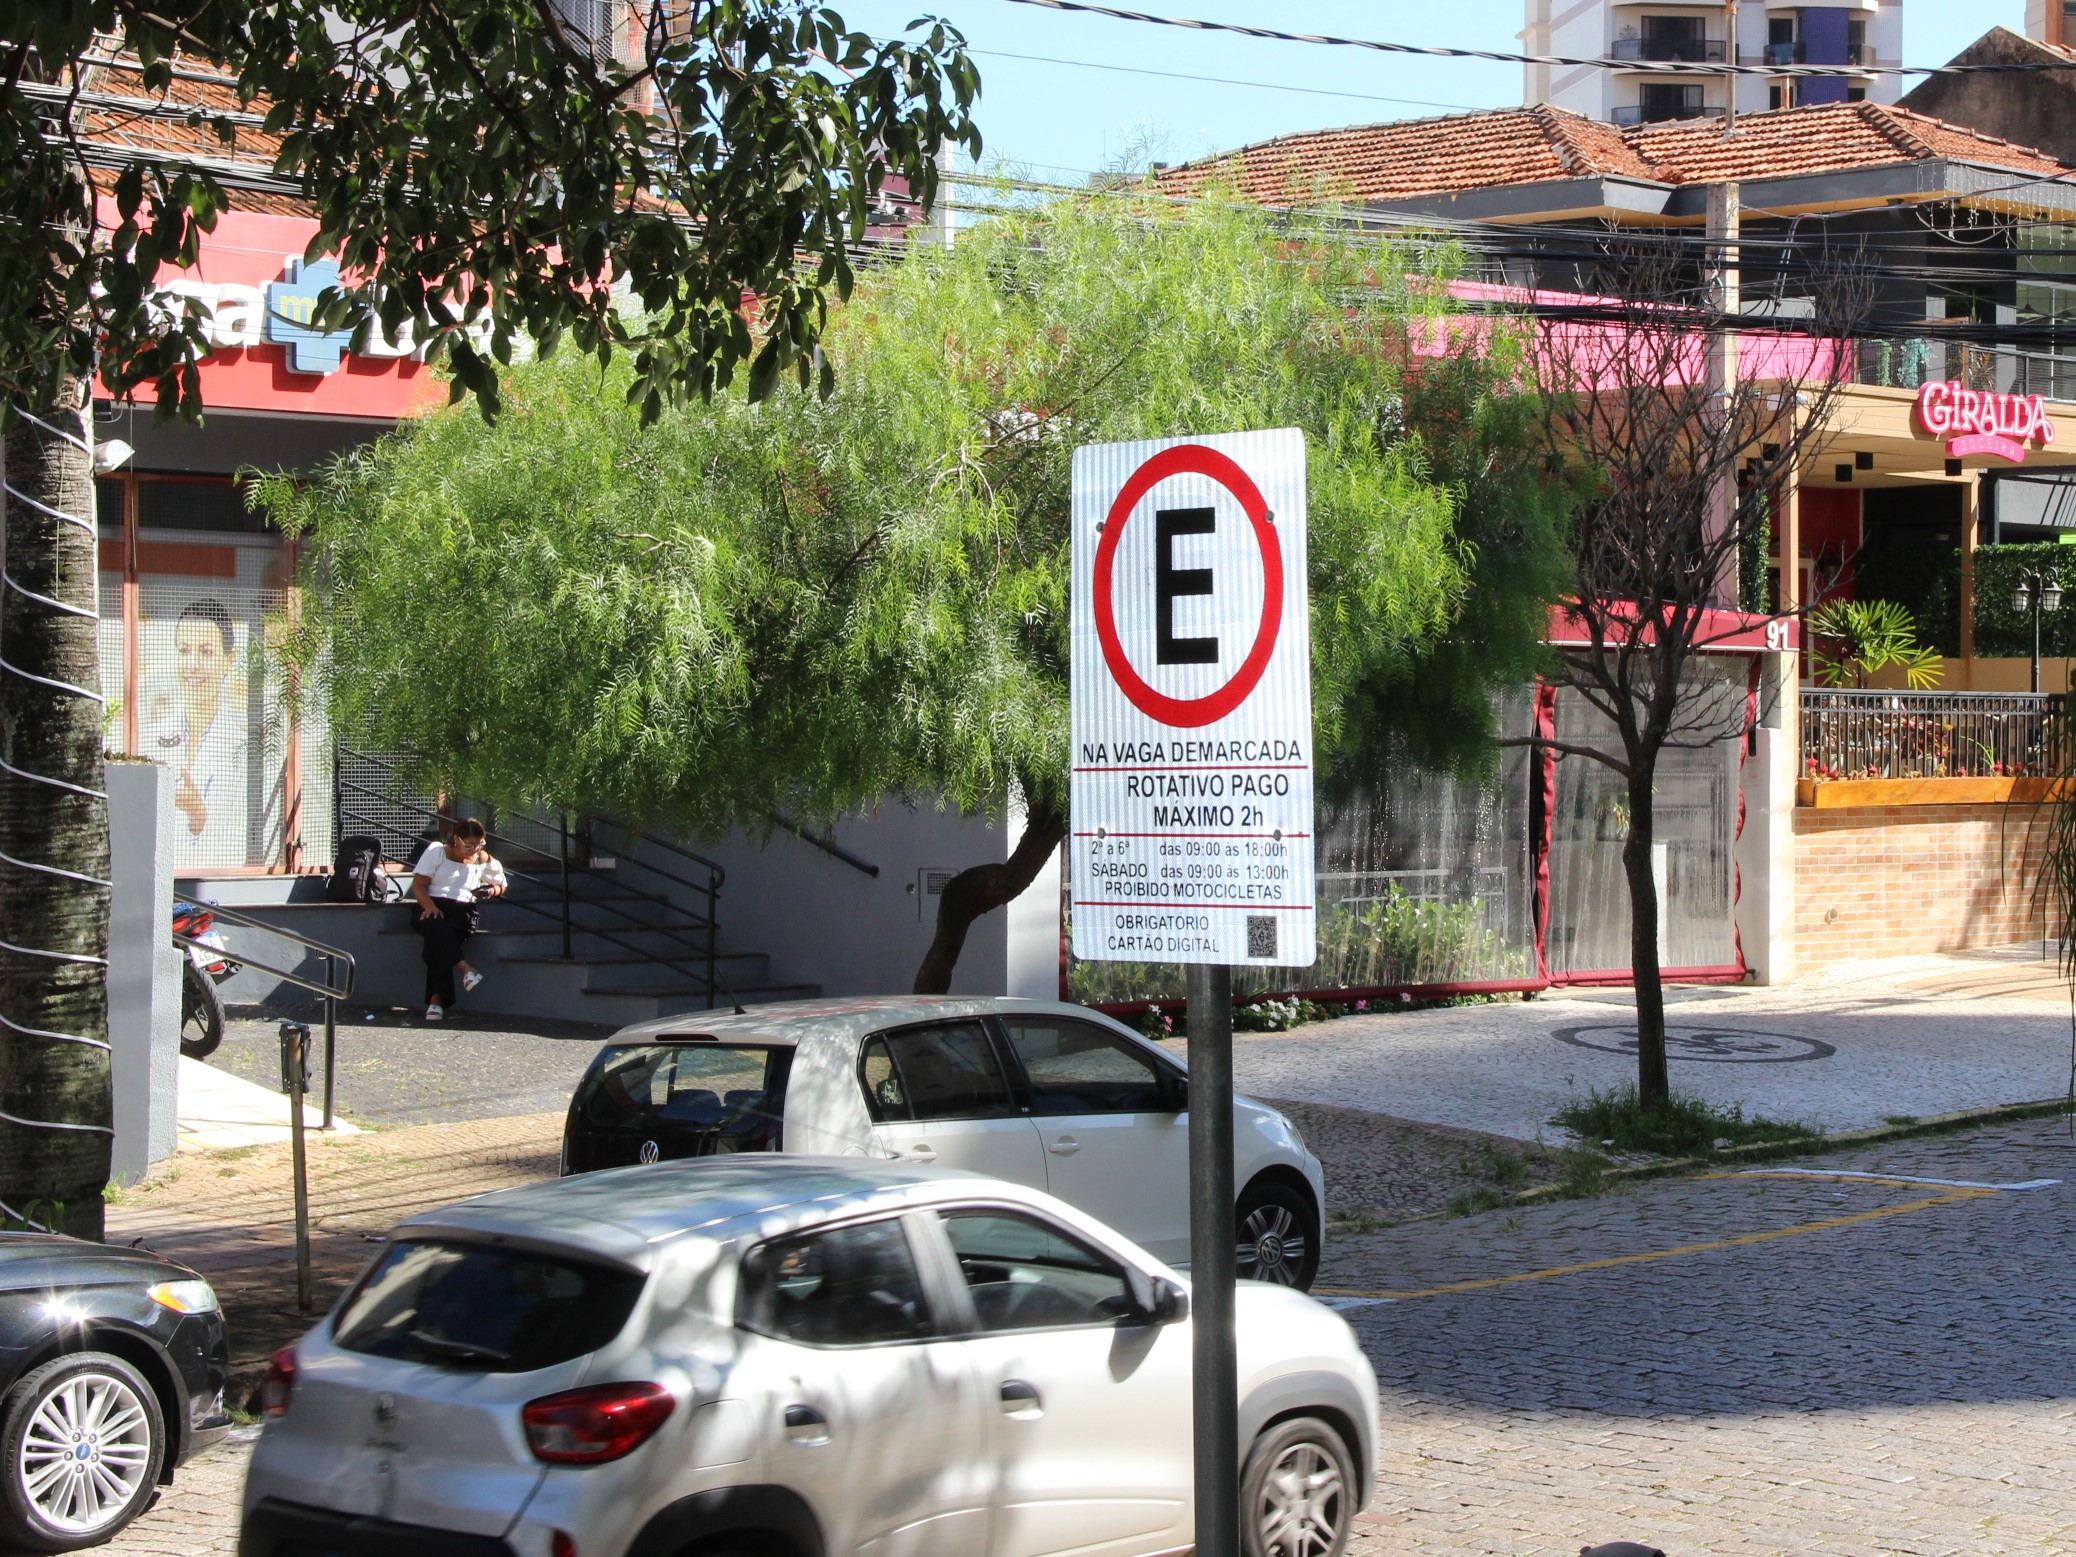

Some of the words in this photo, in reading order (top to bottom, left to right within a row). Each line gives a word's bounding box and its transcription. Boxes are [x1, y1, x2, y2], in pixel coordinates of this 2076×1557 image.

[1156, 507, 1219, 665] E
[1766, 620, 1789, 650] 91
[1082, 743, 1108, 763] NA
[1113, 742, 1166, 763] VAGA
[1171, 740, 1302, 762] DEMARCADA
[1127, 775, 1224, 797] ROTATIVO
[1231, 774, 1289, 797] PAGO
[1154, 800, 1234, 827] MÁXIMO
[1241, 805, 1264, 827] 2h
[1107, 845, 1115, 855] a
[1159, 842, 1182, 857] das
[1185, 842, 1221, 857] 09:00
[1225, 841, 1240, 857] às
[1244, 842, 1288, 858] 18:00h
[1091, 859, 1148, 878] SÁBADO
[1160, 864, 1183, 879] das
[1187, 864, 1222, 879] 09:00
[1226, 864, 1240, 879] às
[1246, 865, 1289, 880] 13:00h
[1105, 881, 1170, 898] PROIBIDO
[1173, 882, 1283, 900] MOTOCICLETAS
[1115, 912, 1210, 931] OBRIGATÓRIO
[1108, 935, 1164, 952] CARTÃO
[1168, 937, 1220, 953] DIGITAL
